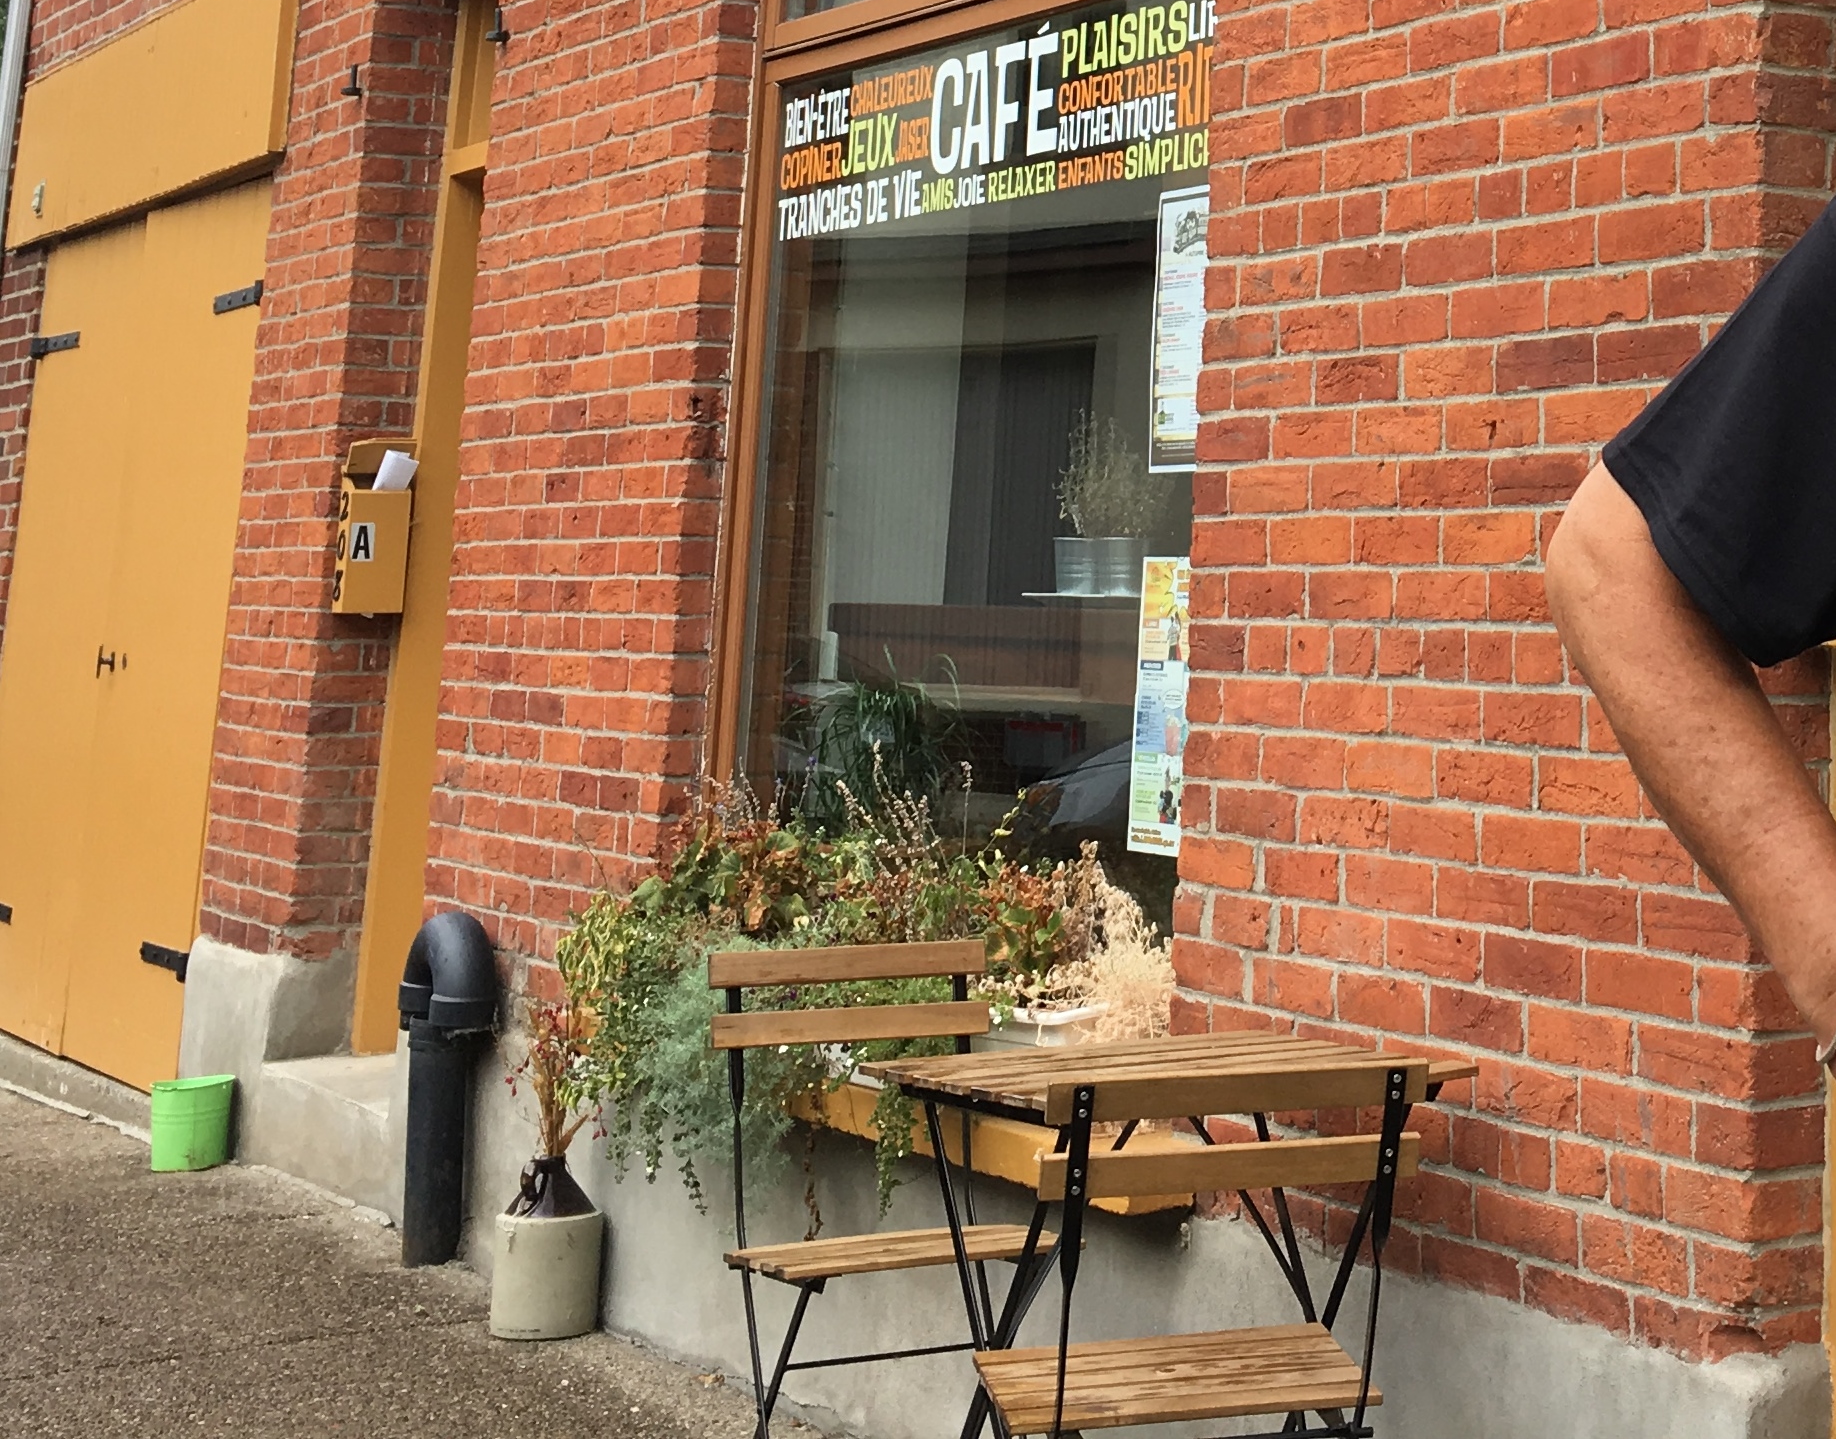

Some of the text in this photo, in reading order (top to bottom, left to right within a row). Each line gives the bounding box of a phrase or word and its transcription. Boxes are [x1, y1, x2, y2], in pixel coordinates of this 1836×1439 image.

[1061, 0, 1189, 79] PLAISIRS
[785, 64, 934, 148] BIEN-ÊTRE CHALEUREUX
[930, 20, 1059, 175] CAFÉ
[1057, 92, 1177, 154] AUTHENTIQUE
[1058, 58, 1178, 115] CONFORTABLE
[780, 112, 930, 191] COPINER JEUX JASER
[778, 182, 863, 242] TRANCHES
[866, 177, 889, 225] DE
[893, 169, 922, 220] VIE
[921, 177, 954, 214] AMIS
[953, 174, 986, 209] JOIE
[987, 160, 1056, 203] RELAXER
[1058, 150, 1124, 190] ENFANTS
[333, 491, 349, 602] 208
[352, 525, 370, 559] A
